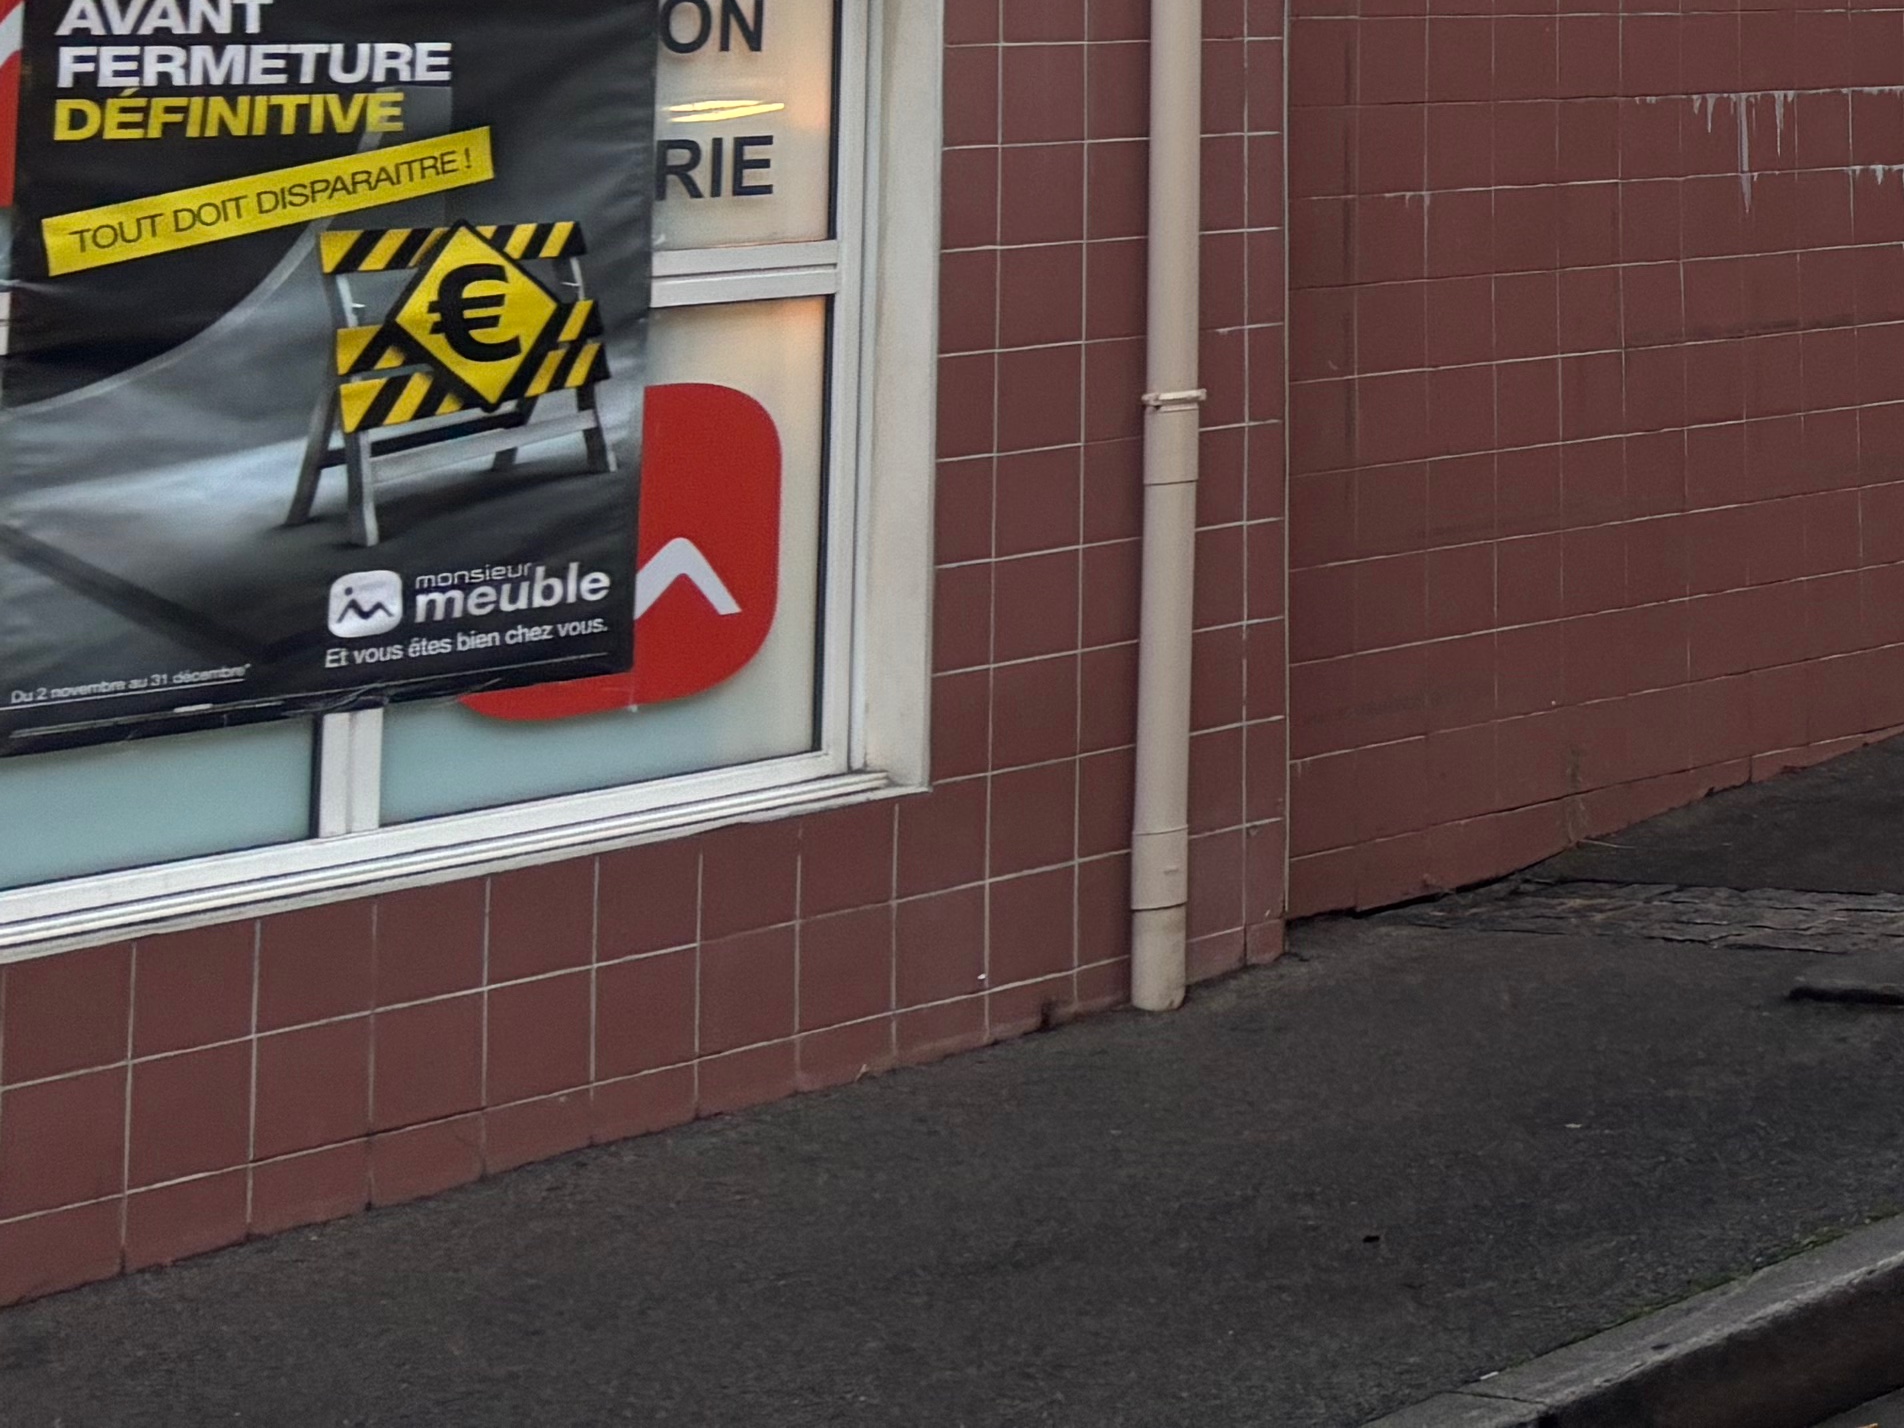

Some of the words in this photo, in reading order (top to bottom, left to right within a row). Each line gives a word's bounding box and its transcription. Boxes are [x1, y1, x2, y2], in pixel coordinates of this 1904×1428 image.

[55, 41, 454, 89] FERMETURE
[52, 87, 406, 142] DÉFINITIVE
[68, 211, 164, 255] TOUT
[172, 193, 248, 234] DOIT
[255, 151, 458, 215] DISPARAITRE
[413, 561, 612, 624] meuble
[414, 561, 533, 590] monsieur
[324, 646, 350, 669] Et
[353, 643, 404, 665] vous
[456, 628, 501, 652] bien
[503, 623, 554, 645] chez
[557, 617, 609, 638] vous.
[36, 687, 49, 700] 2
[150, 673, 169, 687] 31
